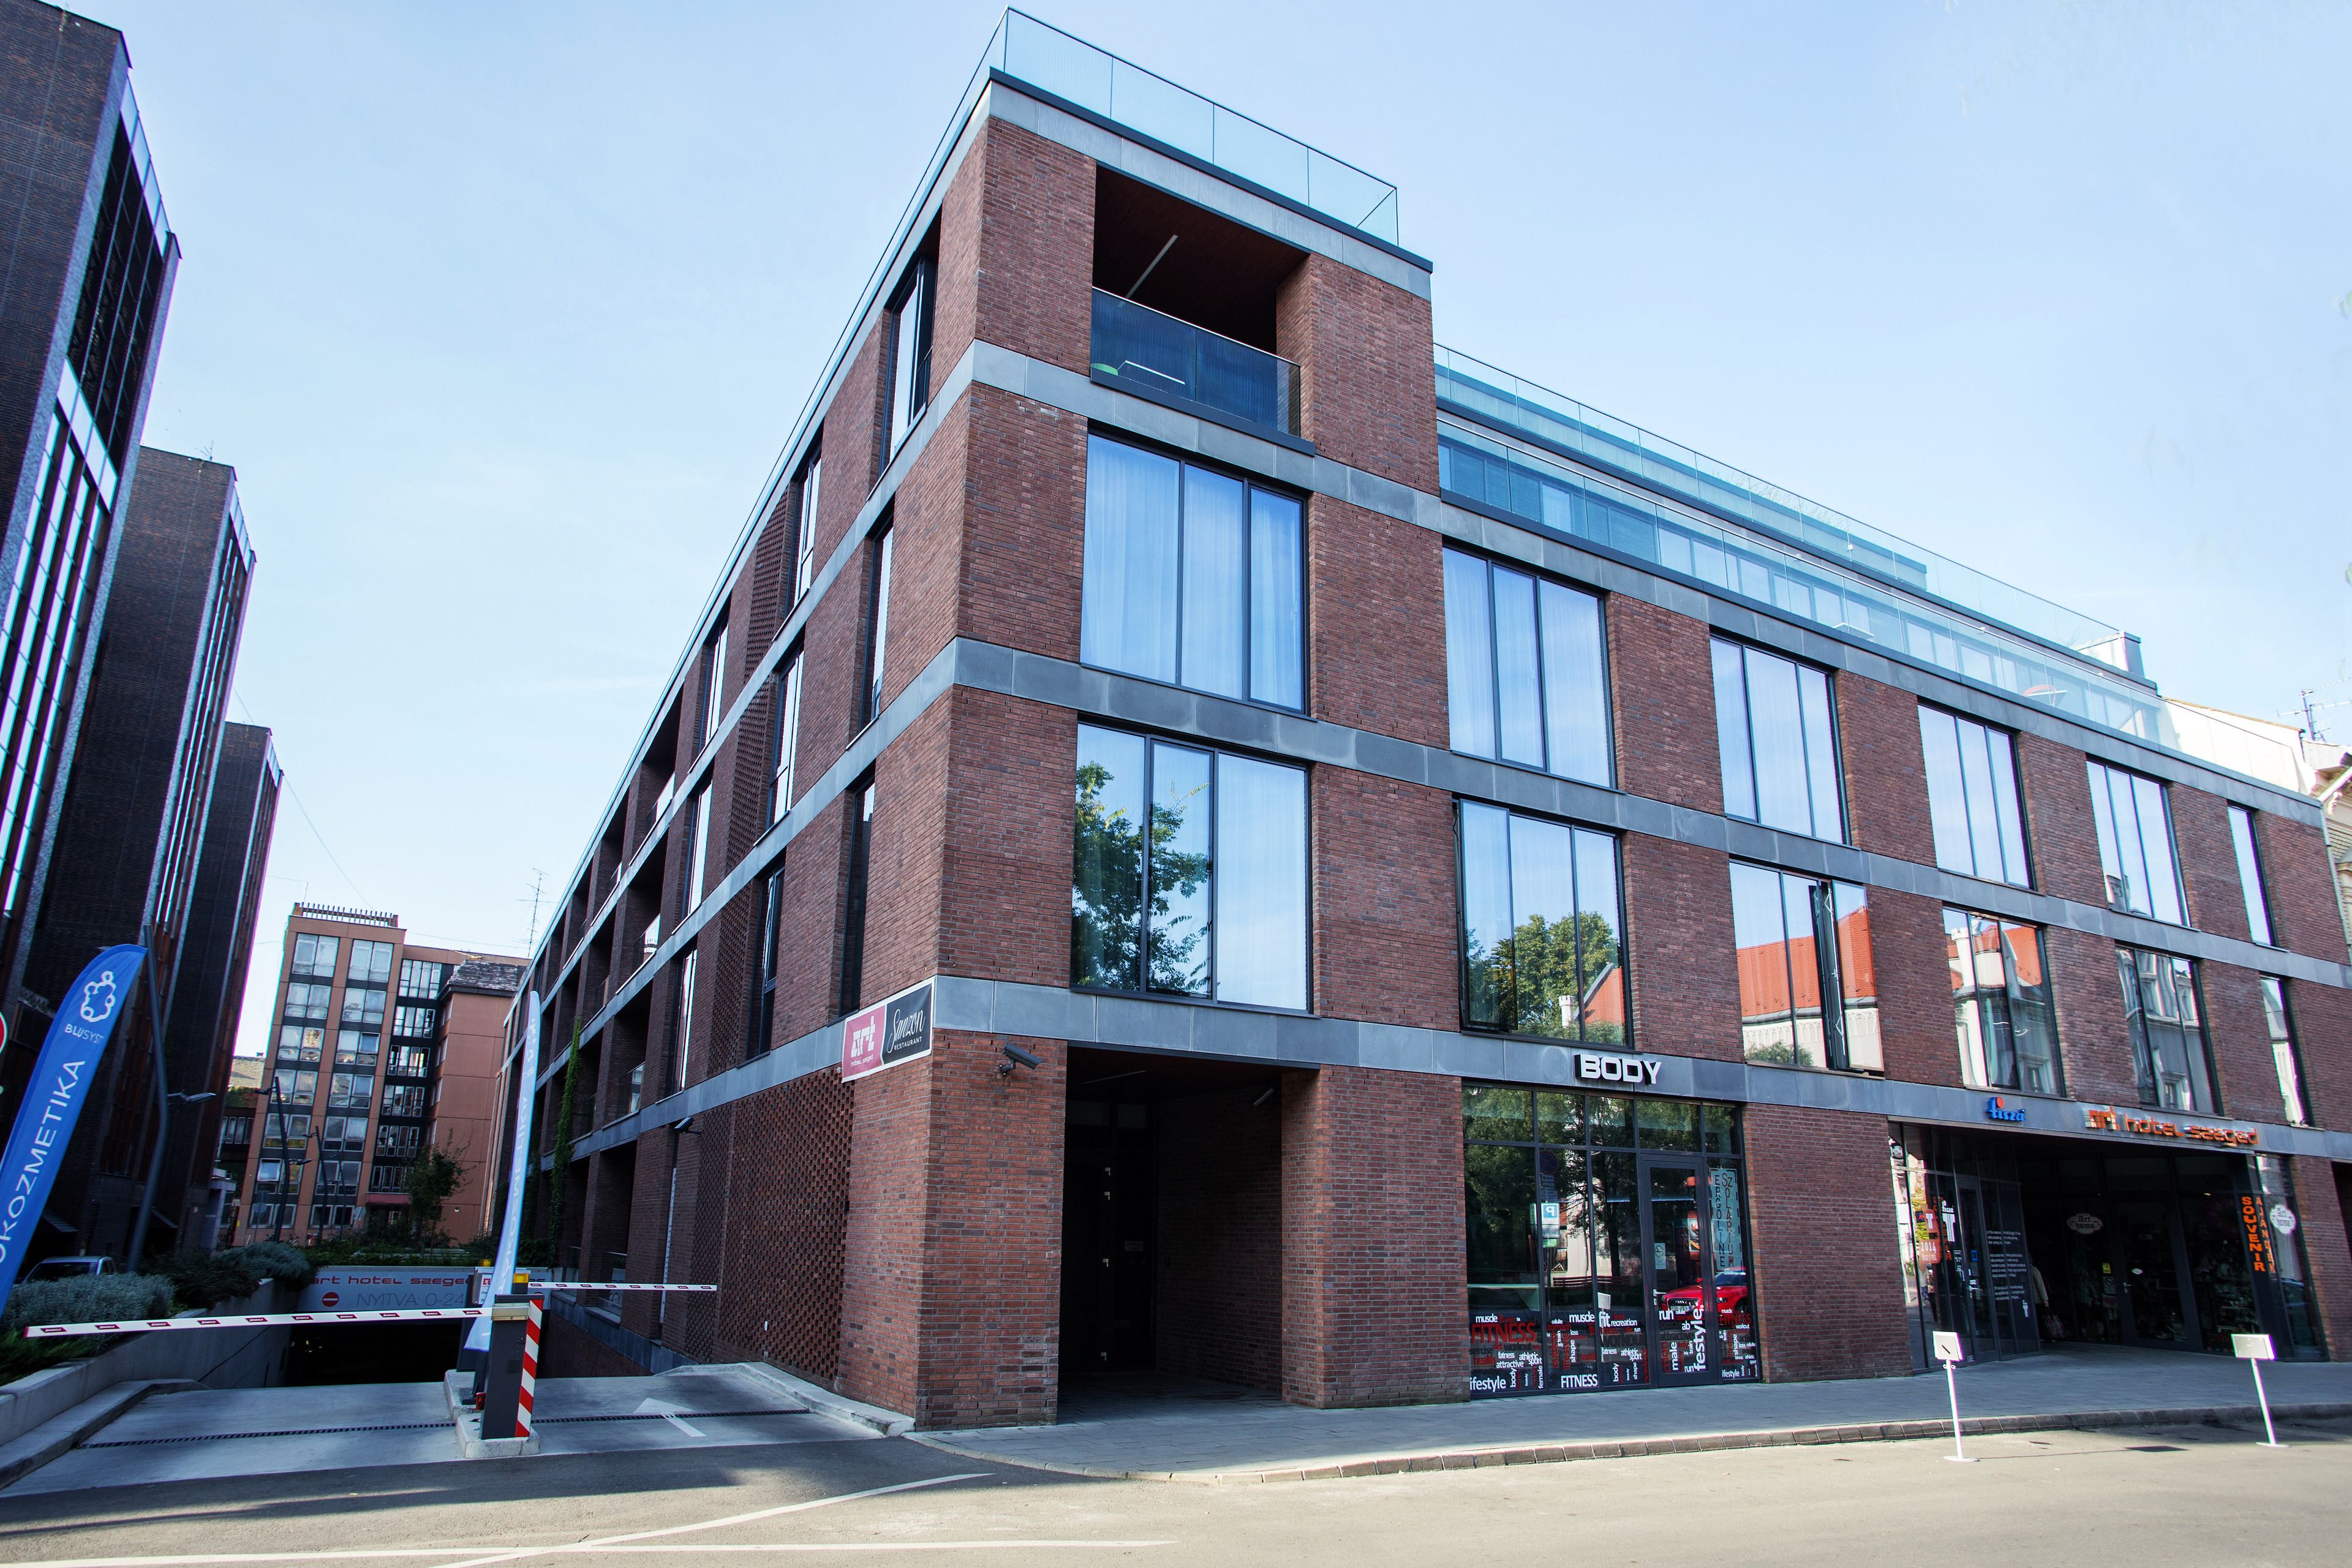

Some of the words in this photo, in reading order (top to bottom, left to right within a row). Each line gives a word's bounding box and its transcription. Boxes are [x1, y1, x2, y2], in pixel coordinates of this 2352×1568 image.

[64, 1023, 105, 1044] BLUSYST
[887, 1009, 925, 1054] Sanzon
[894, 1036, 922, 1050] RESTAURANT
[1575, 1054, 1662, 1085] BODY
[2120, 1112, 2184, 1137] hotel
[2184, 1125, 2259, 1147] szeged
[2242, 1196, 2266, 1272] SOUVENIR
[1921, 1242, 1936, 1254] 2014
[348, 1276, 402, 1284] hotel
[1569, 1311, 1595, 1323] muscle
[1599, 1311, 1611, 1328] fit
[1659, 1310, 1674, 1320] run
[1611, 1318, 1637, 1327] recreation
[1681, 1321, 1691, 1330] ab
[1471, 1322, 1537, 1343] FITNESS
[1519, 1352, 1539, 1360] athletic
[1528, 1357, 1542, 1366] sport
[1629, 1352, 1642, 1362] sport
[1670, 1341, 1679, 1371] male
[1496, 1360, 1524, 1369] attractive
[1561, 1374, 1598, 1389] FITNESS
